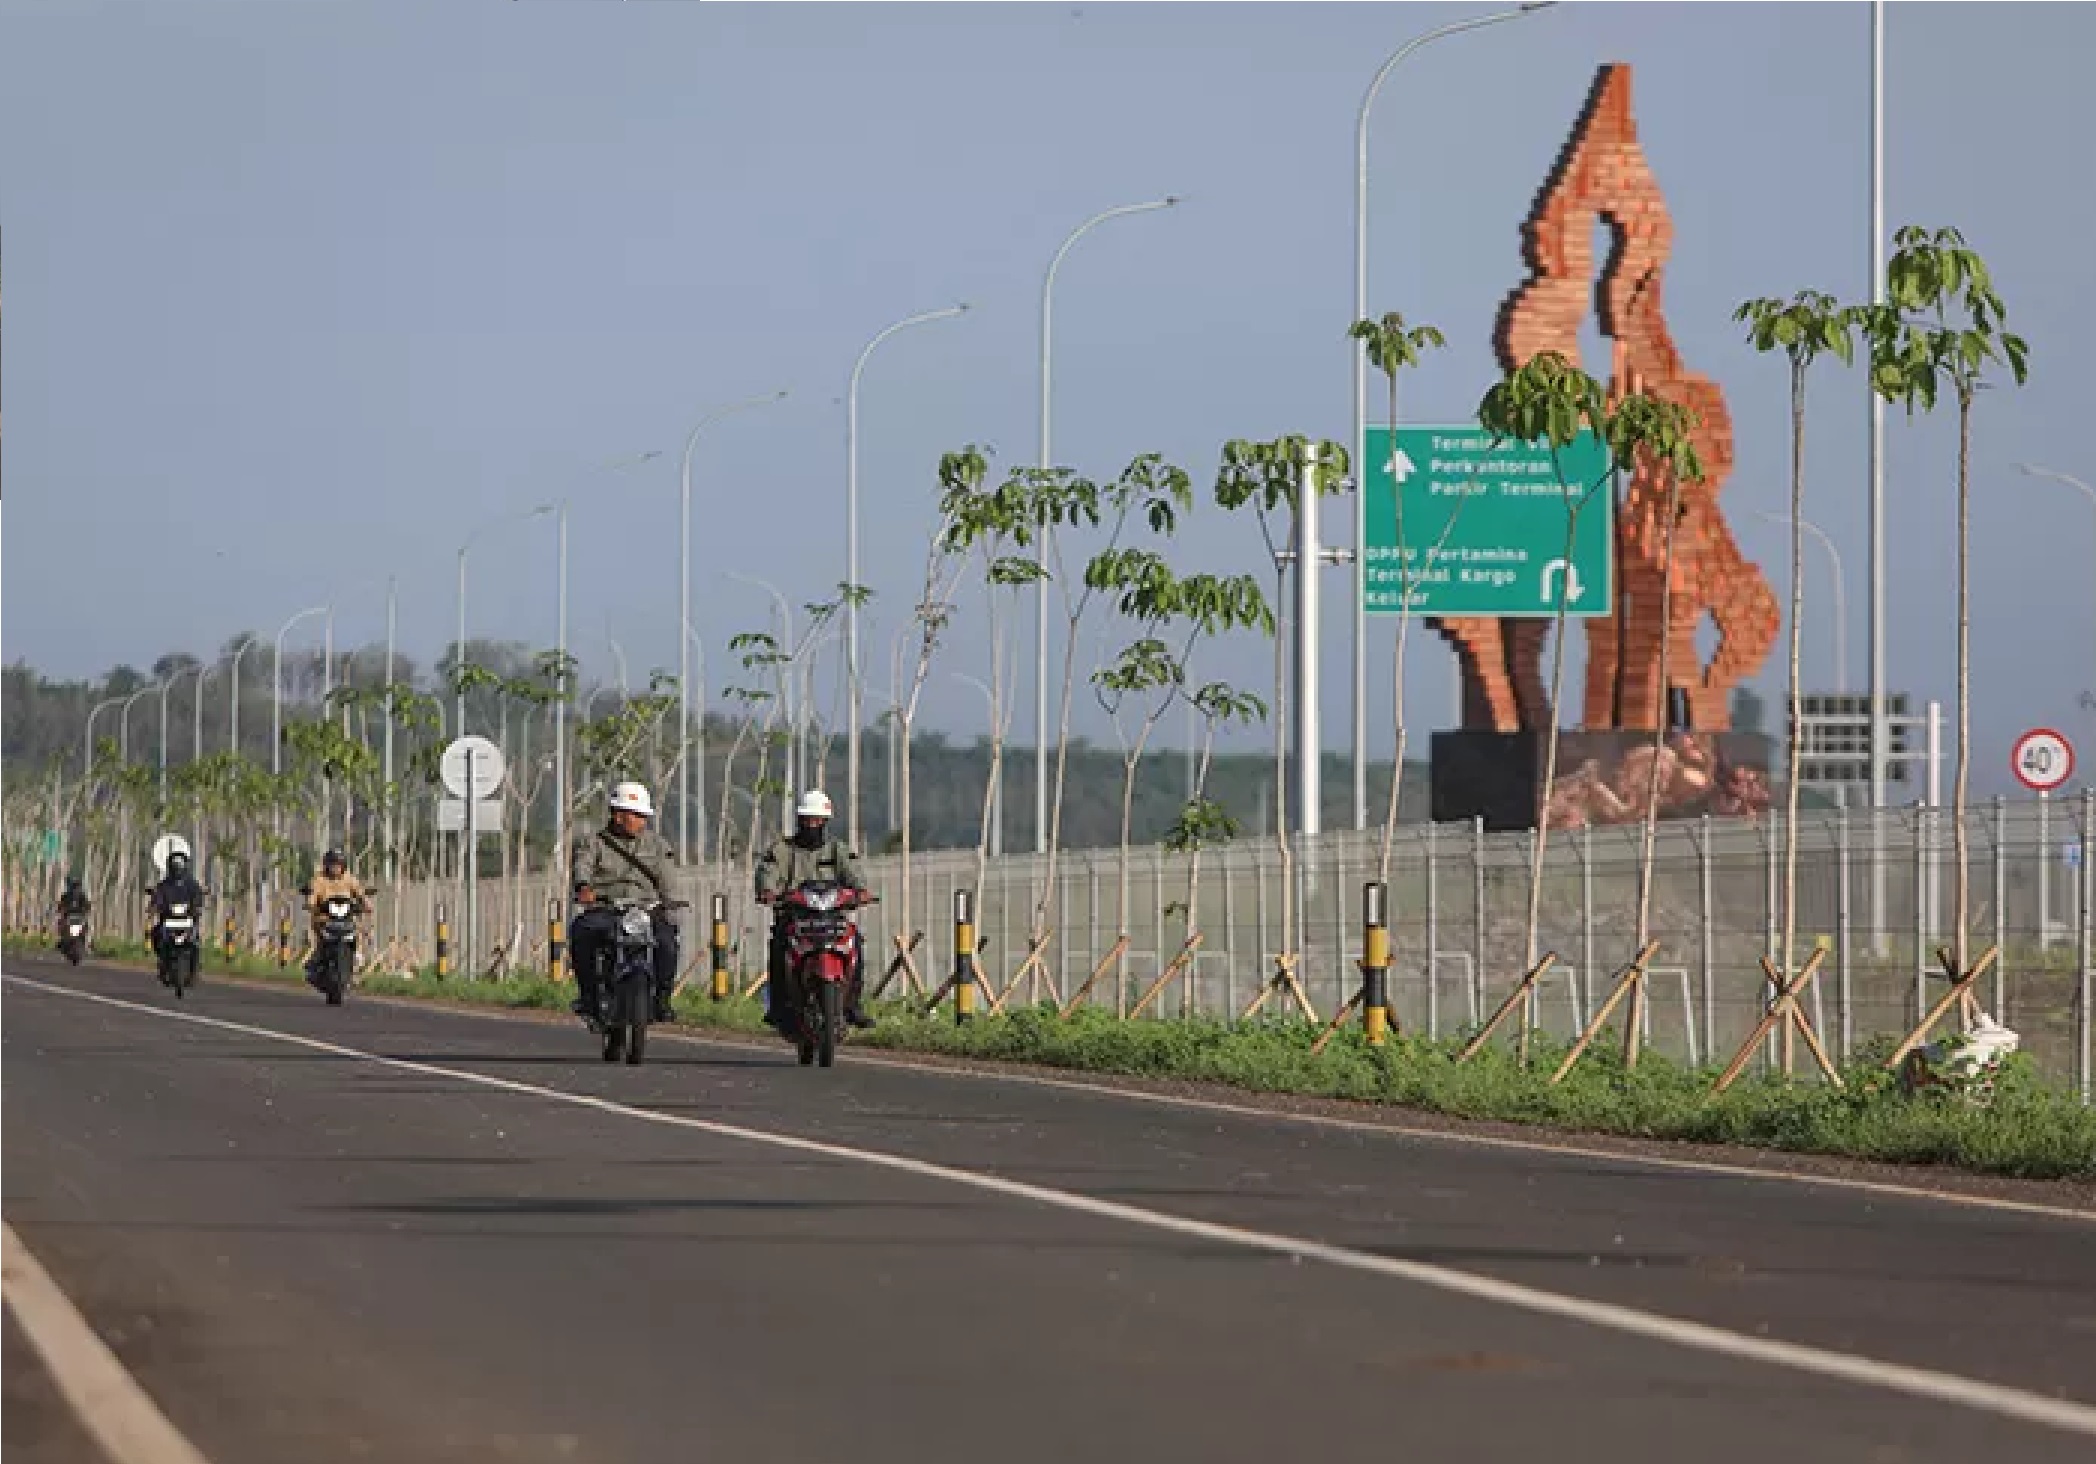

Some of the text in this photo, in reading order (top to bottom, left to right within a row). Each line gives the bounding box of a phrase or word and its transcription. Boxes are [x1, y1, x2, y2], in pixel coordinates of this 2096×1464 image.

[1432, 436, 1516, 451] Terminal
[1500, 481, 1583, 495] Terminal
[1426, 546, 1529, 561] Pertamina
[1459, 568, 1517, 587] Kargo
